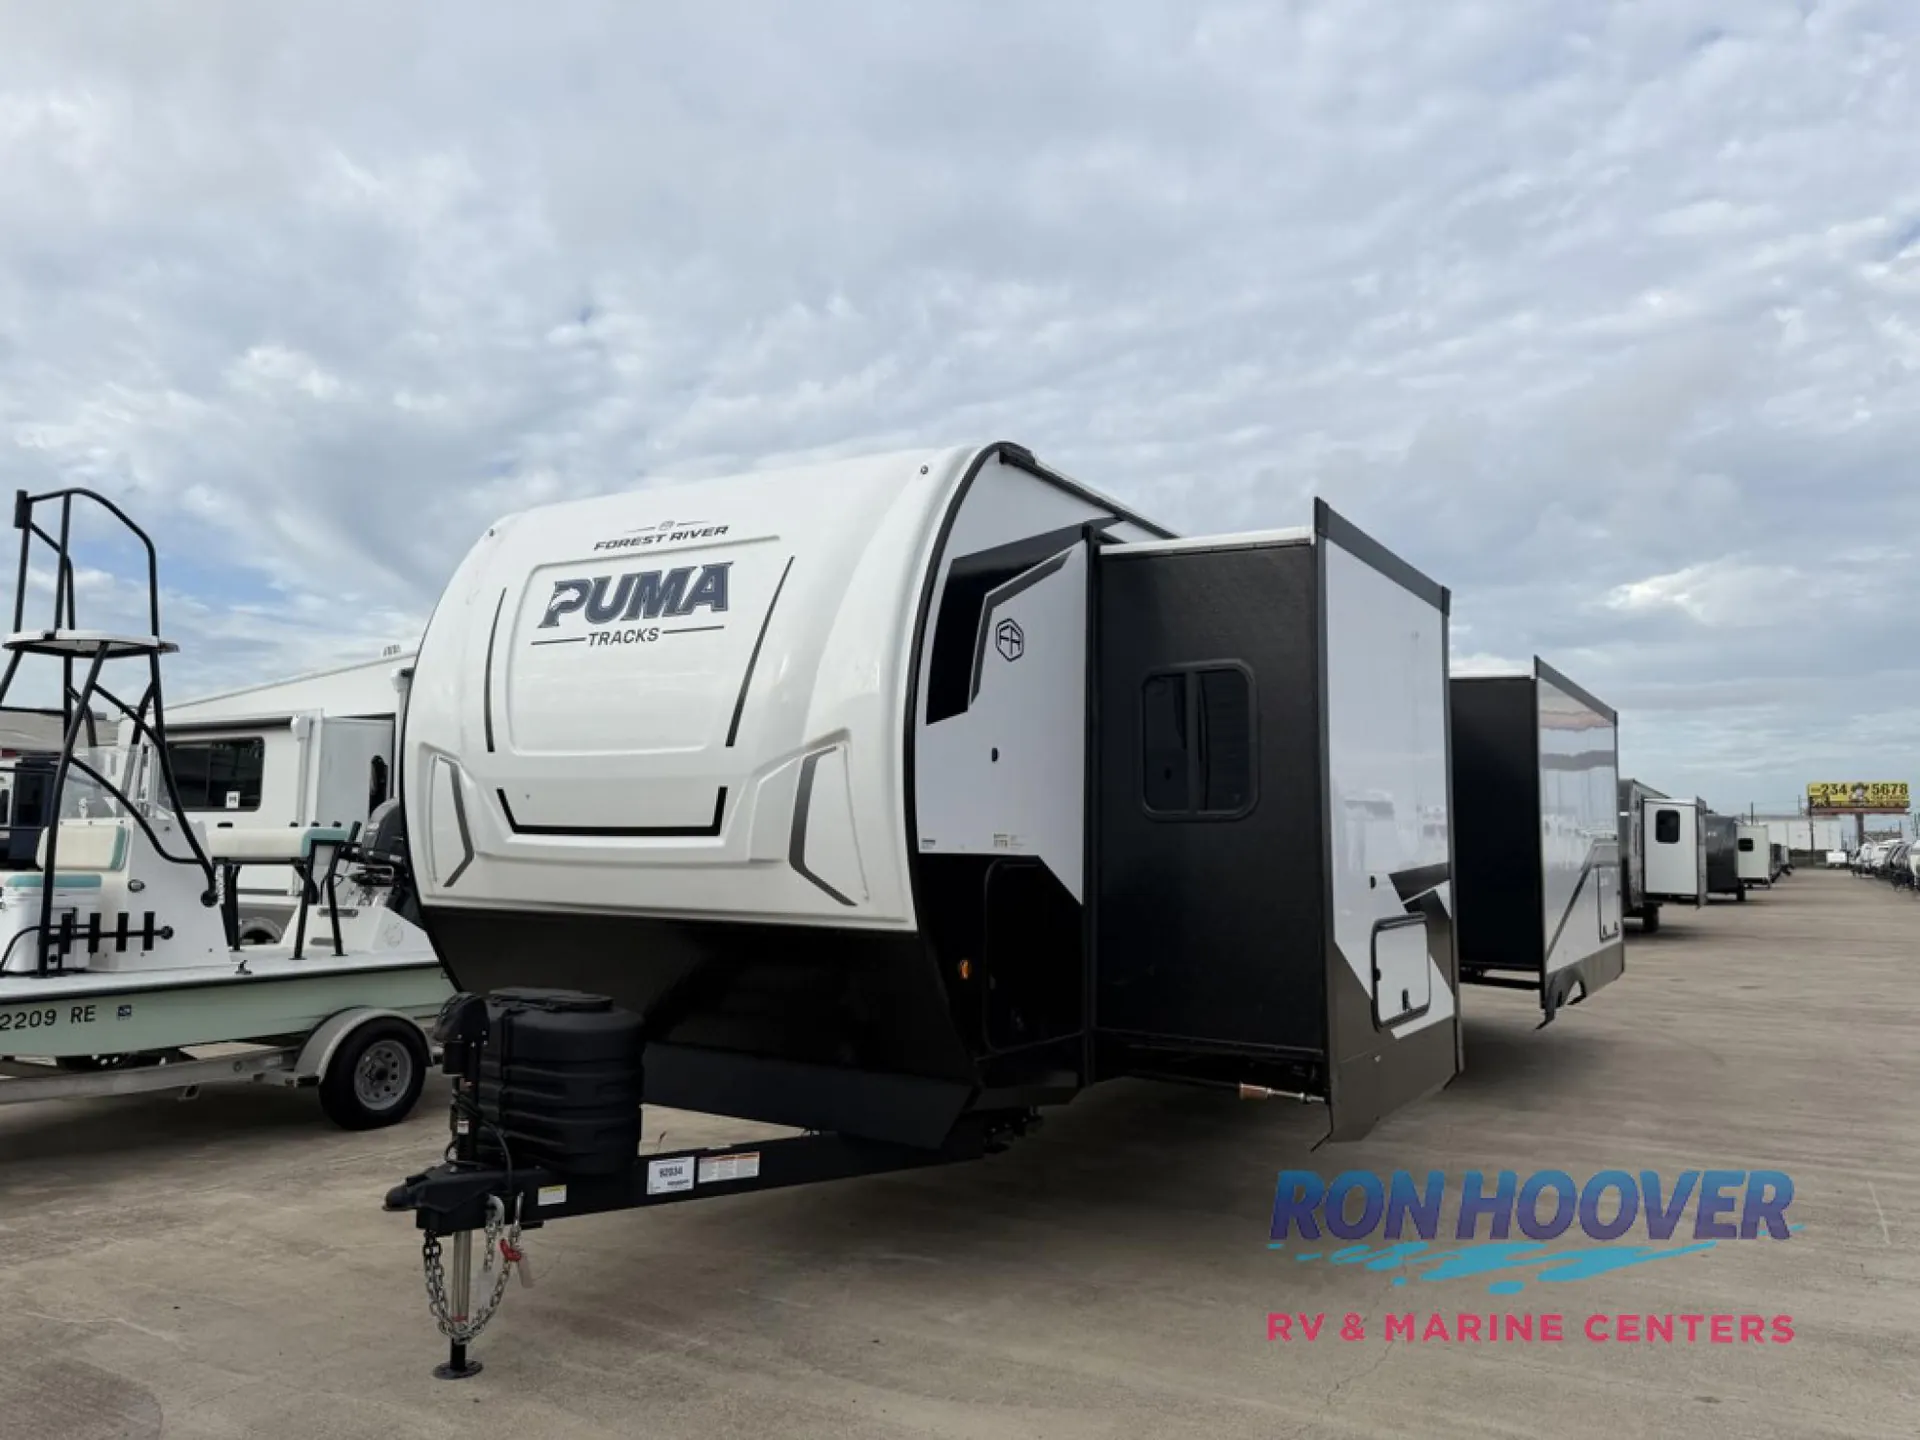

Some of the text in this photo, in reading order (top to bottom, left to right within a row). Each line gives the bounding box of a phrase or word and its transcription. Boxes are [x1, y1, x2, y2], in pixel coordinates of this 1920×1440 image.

[594, 525, 729, 551] FOREST RIVER
[537, 561, 734, 629] PUMA
[588, 627, 660, 648] TRACKS
[1821, 783, 1848, 796] 234
[0, 1008, 57, 1031] 2209
[70, 1005, 96, 1024] RE
